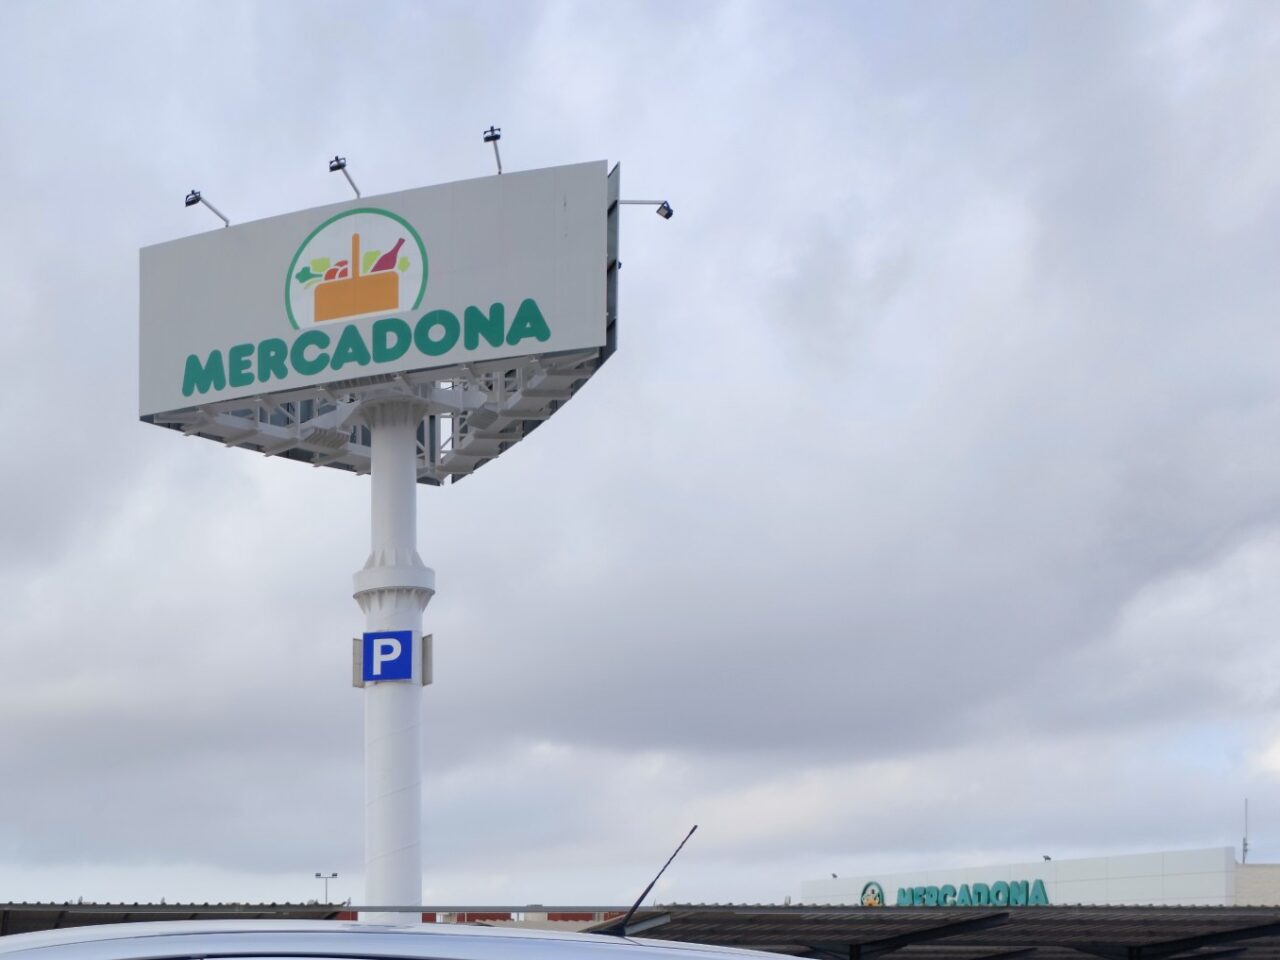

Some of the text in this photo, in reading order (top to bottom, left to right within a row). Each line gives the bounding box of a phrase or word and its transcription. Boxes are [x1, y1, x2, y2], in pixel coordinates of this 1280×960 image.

[182, 298, 552, 398] MERCADONA
[373, 638, 402, 675] P
[896, 879, 1049, 906] MERCADONA
